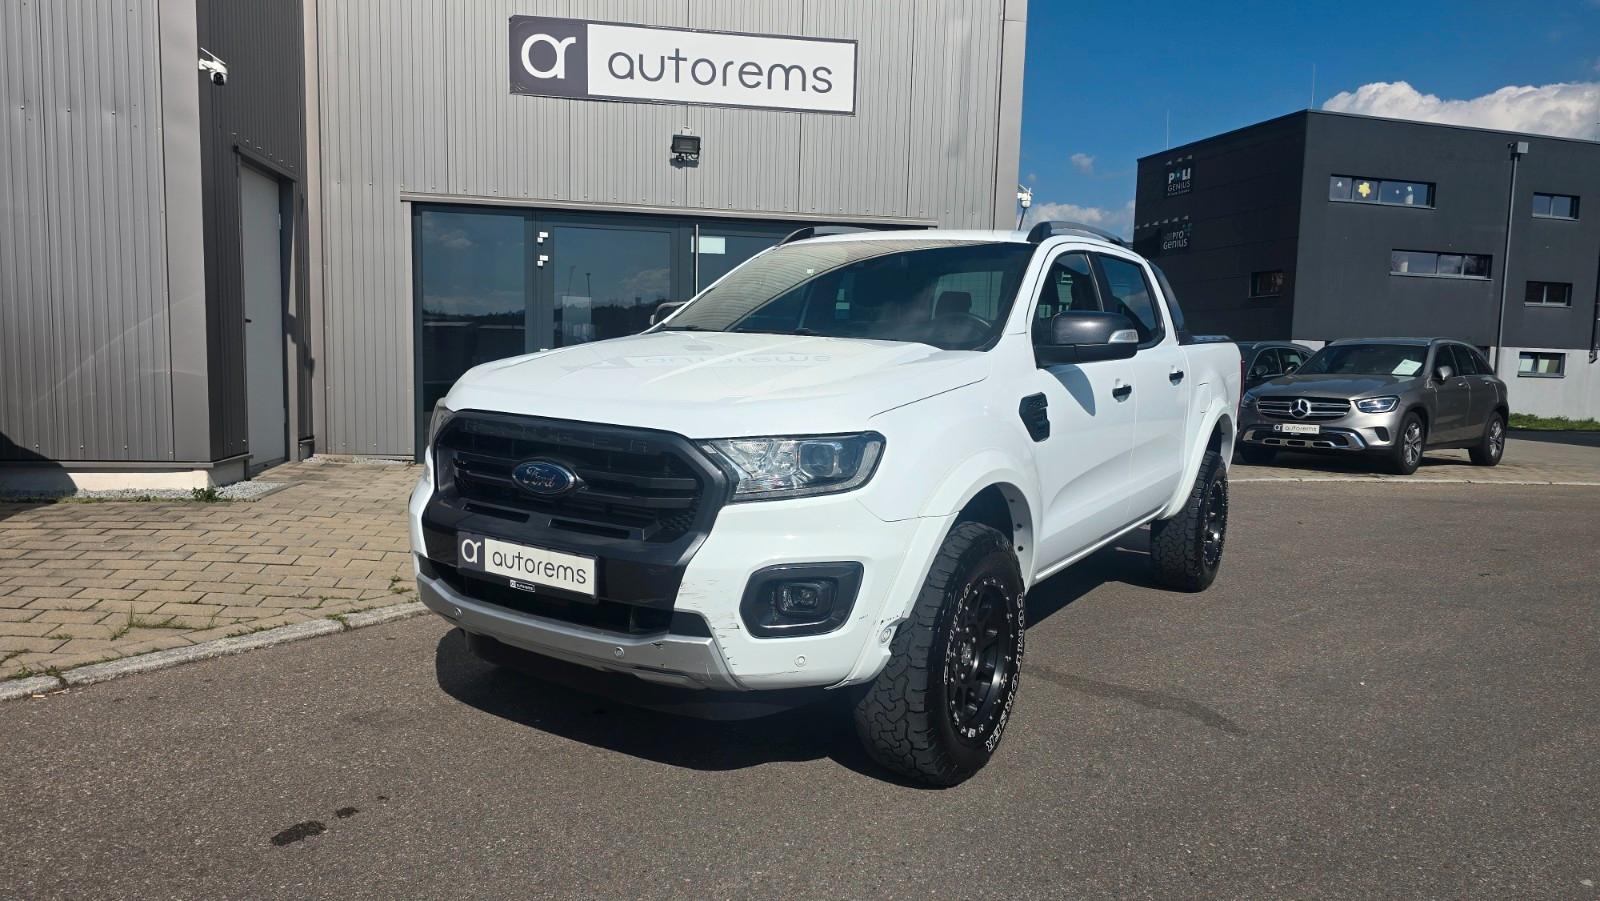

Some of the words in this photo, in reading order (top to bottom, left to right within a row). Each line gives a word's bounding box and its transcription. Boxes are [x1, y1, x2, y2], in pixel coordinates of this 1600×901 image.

[608, 48, 833, 94] autorems
[522, 466, 557, 488] Ford
[492, 551, 587, 585] autorems
